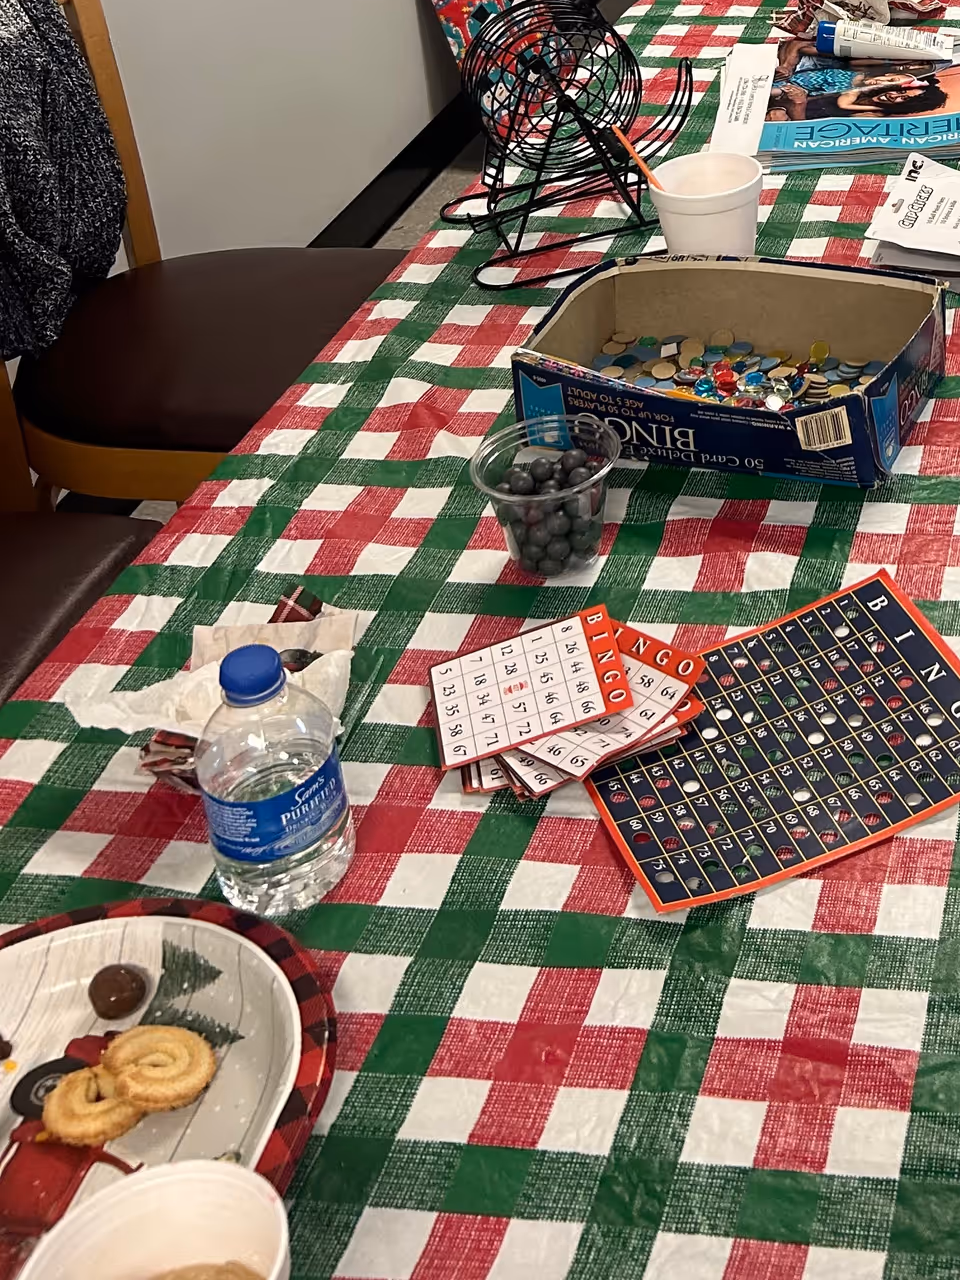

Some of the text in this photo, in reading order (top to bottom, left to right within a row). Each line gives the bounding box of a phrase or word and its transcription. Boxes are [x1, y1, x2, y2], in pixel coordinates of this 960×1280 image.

[793, 136, 890, 149] AMERICAN
[567, 386, 644, 409] AGE 5 TO ADULT
[567, 396, 675, 423] FOR UP TO 50 PLAYERS
[640, 446, 694, 463] Deluxe
[701, 452, 740, 467] Card
[744, 458, 764, 470] 50
[500, 645, 514, 656] 12
[534, 652, 549, 664] 25
[586, 612, 627, 703] BINGO
[614, 626, 694, 676] INGO
[504, 663, 519, 675] 28
[539, 672, 554, 684] 45
[560, 625, 597, 714] 8 26 44 48 66
[864, 631, 877, 643] 16
[889, 666, 904, 677] 31
[919, 702, 934, 714] 46
[442, 684, 456, 697] 23
[635, 675, 679, 701] 58 64
[802, 615, 923, 772] 3 18 33 48 63
[821, 607, 943, 762] 2 17 32 47 62
[445, 704, 460, 716] 35
[469, 656, 500, 747] 7 18 34 47 71
[512, 702, 527, 713] 57
[544, 692, 559, 705] 46
[549, 711, 565, 725] 64
[639, 709, 656, 721] 61
[809, 659, 821, 669] 19
[832, 693, 848, 705] 34
[860, 731, 874, 742] 49
[888, 769, 904, 782] 64
[448, 723, 463, 737] 58
[516, 722, 532, 736] 72
[616, 726, 636, 739] 74
[769, 674, 783, 685] 21
[793, 710, 809, 722] 36
[819, 748, 834, 760] 51
[847, 787, 863, 800] 66
[789, 666, 802, 677] 20
[813, 701, 828, 714] 35
[840, 739, 854, 751] 50
[868, 778, 883, 791] 65
[452, 744, 467, 757] 67
[592, 738, 611, 749] 71
[730, 690, 744, 701] 23
[753, 727, 768, 739] 38
[778, 765, 793, 777] 53
[805, 804, 820, 817] 68
[750, 682, 763, 694] 22
[773, 718, 789, 729] 37
[799, 756, 814, 769] 52
[826, 796, 842, 808] 67
[517, 755, 535, 767] 49
[546, 744, 588, 767] 46 65
[710, 698, 799, 825] 24 39 54 69
[490, 768, 504, 781] 61
[533, 772, 553, 785] 66
[290, 775, 325, 810] Sam's
[693, 750, 755, 842] 41 56 71
[713, 743, 777, 834] 40 55 70
[280, 777, 337, 826] PURIFIED
[651, 766, 711, 858] 43 58 73
[672, 758, 734, 850] 42 57 72
[608, 780, 666, 871] 45 60 75
[628, 773, 689, 865] 44 59 74
